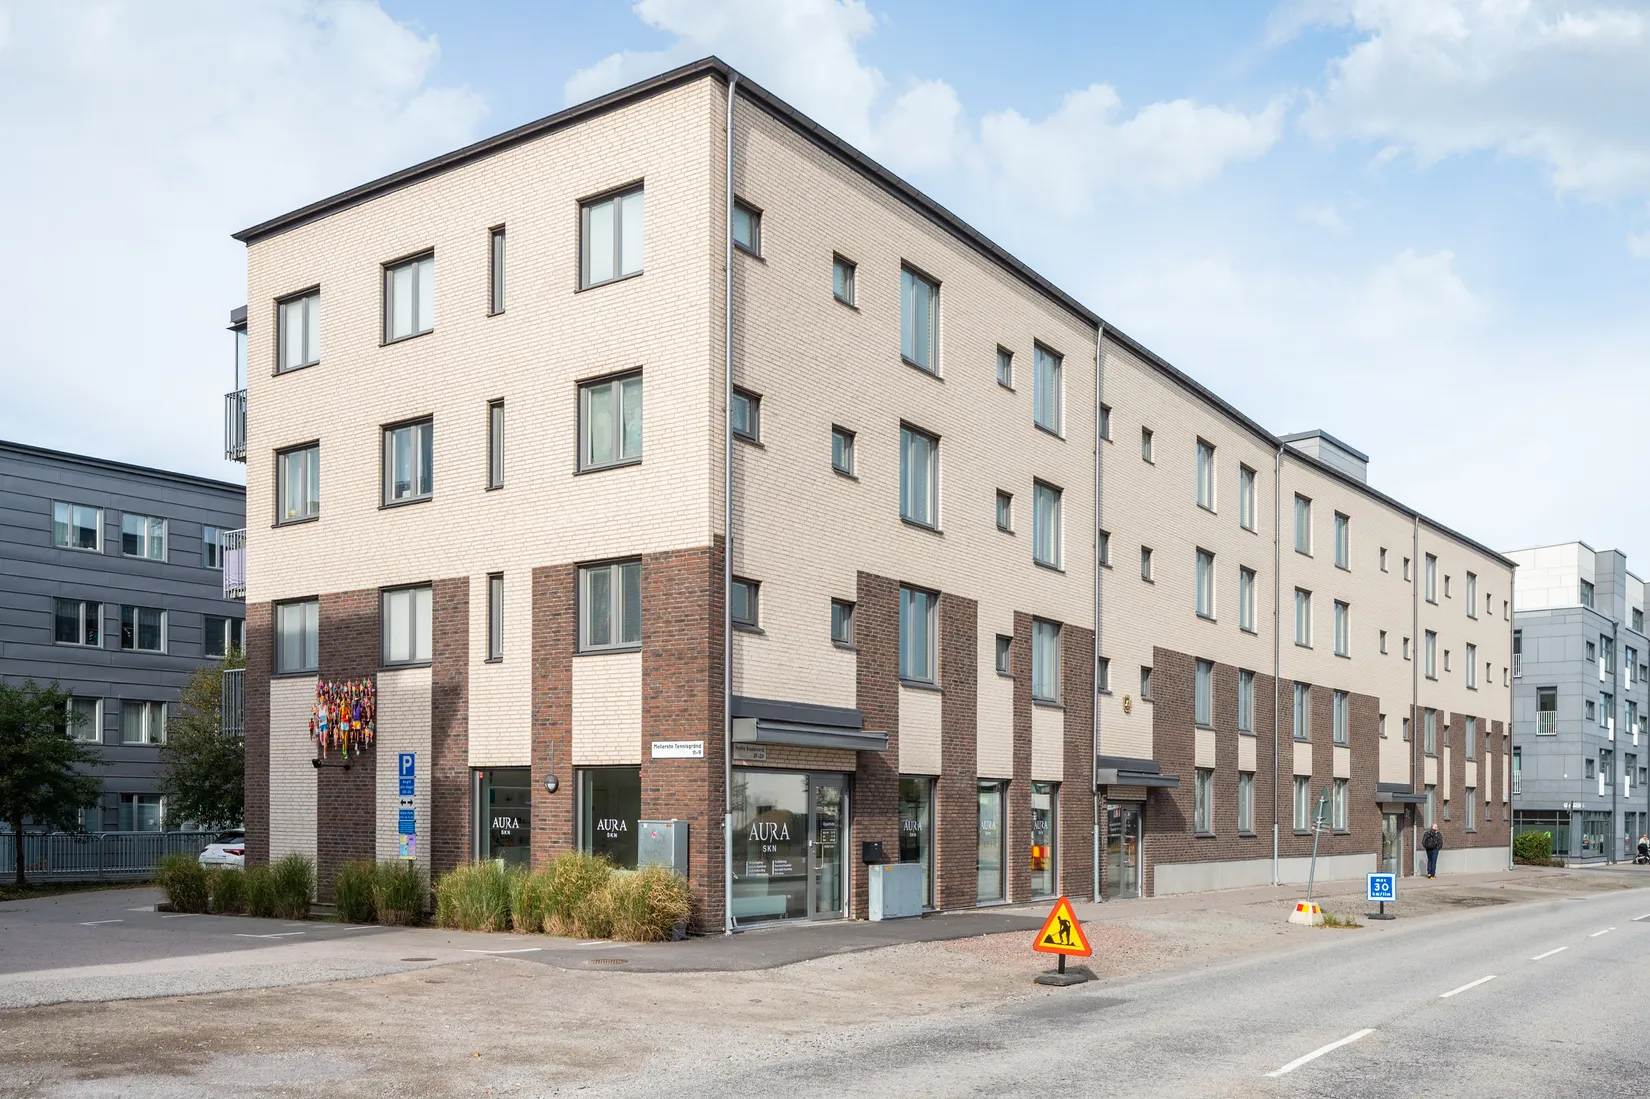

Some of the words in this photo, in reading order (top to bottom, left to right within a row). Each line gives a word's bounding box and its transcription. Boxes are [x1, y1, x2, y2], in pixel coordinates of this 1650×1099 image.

[402, 755, 412, 775] P
[492, 817, 520, 829] AURA
[597, 819, 627, 832] AURA
[903, 820, 922, 832] AURA
[981, 820, 996, 830] AURA
[748, 822, 791, 843] AURA
[762, 844, 777, 852] SKN
[1374, 883, 1390, 892] 30
